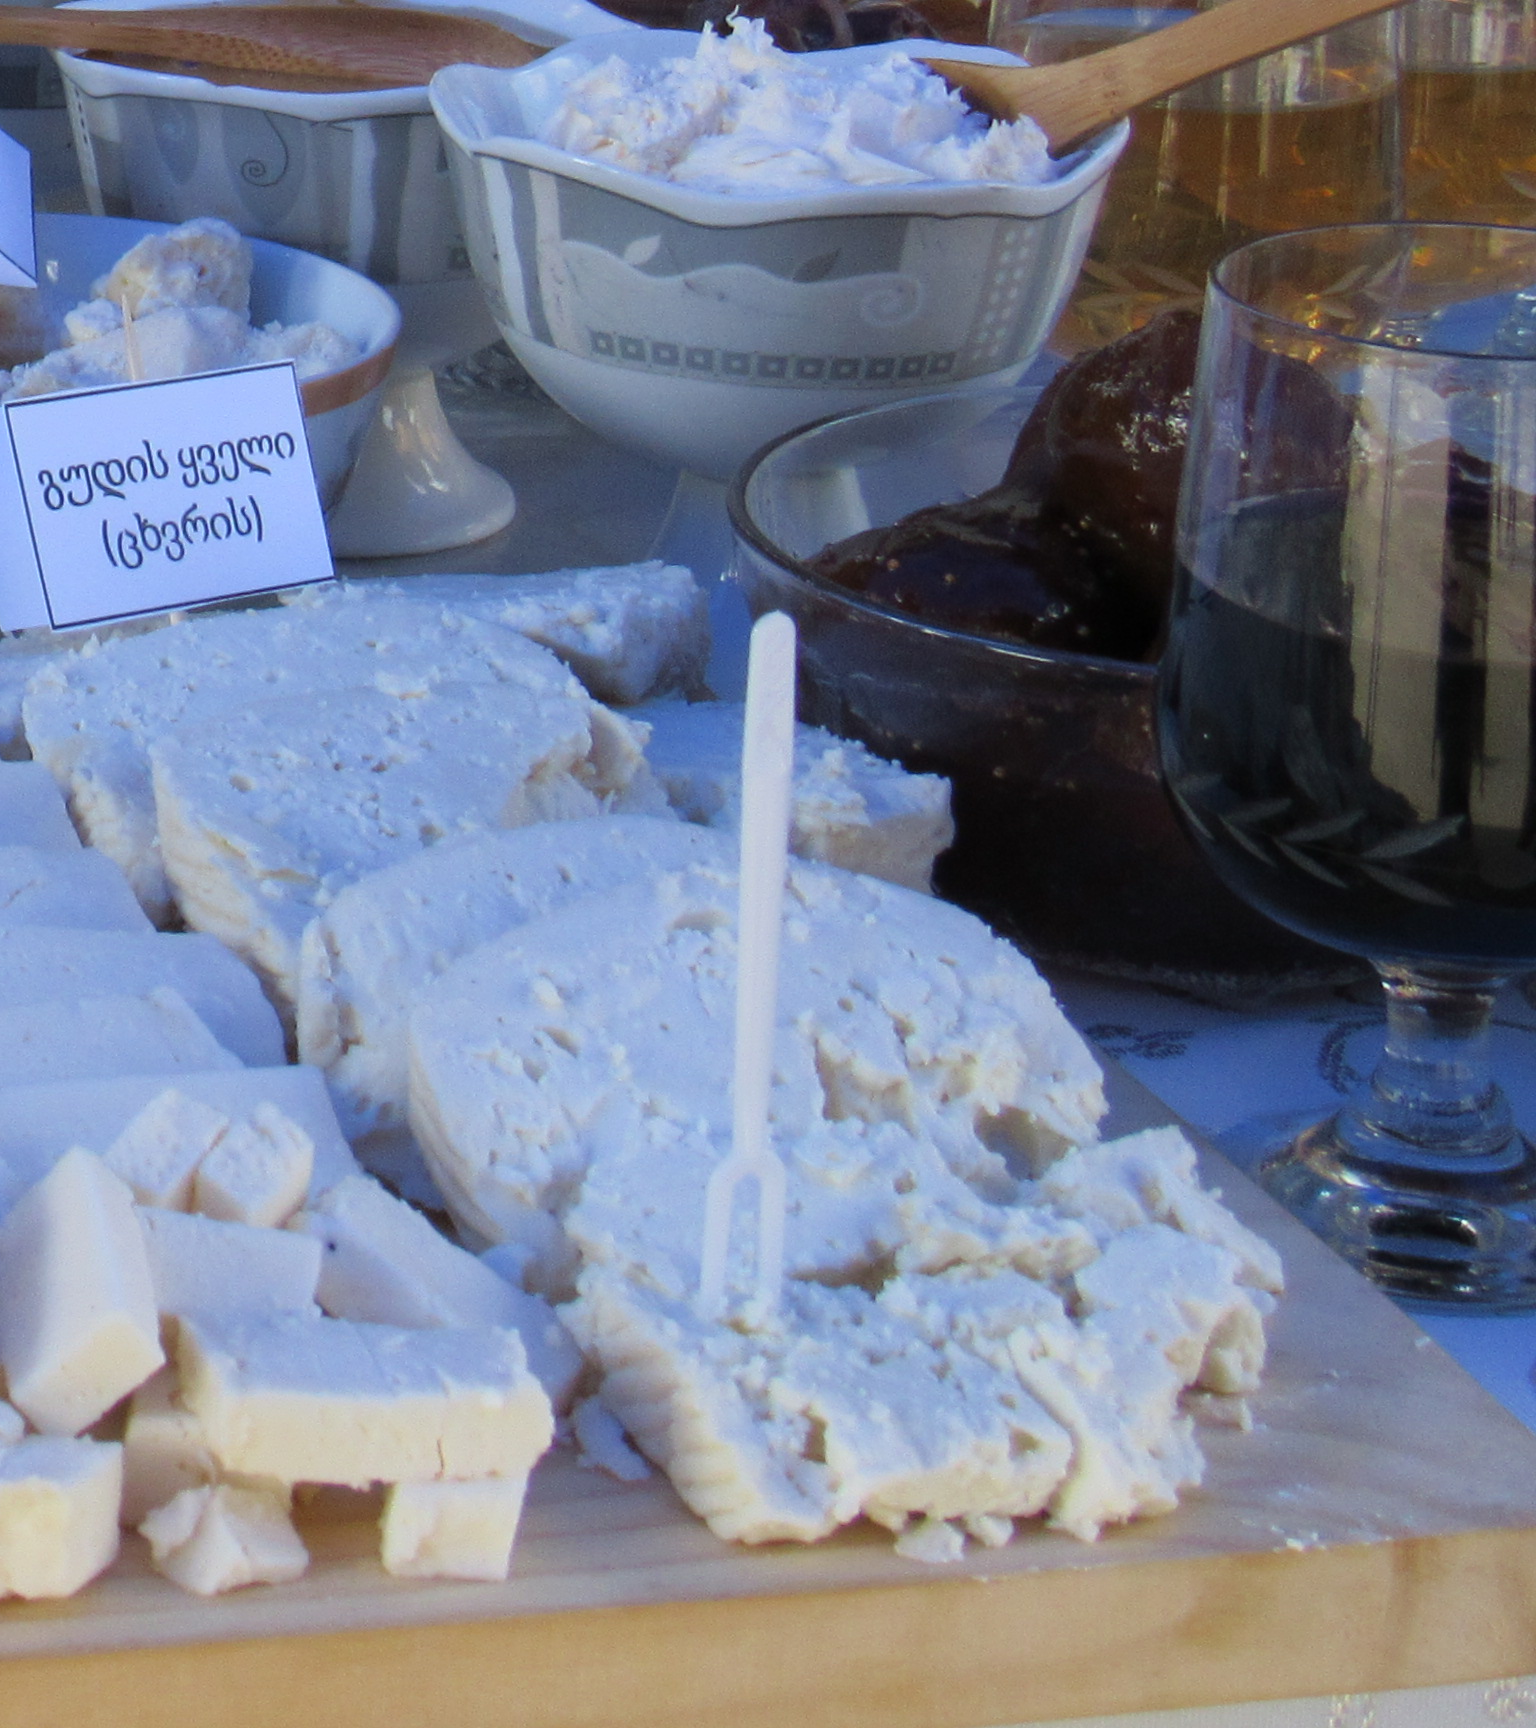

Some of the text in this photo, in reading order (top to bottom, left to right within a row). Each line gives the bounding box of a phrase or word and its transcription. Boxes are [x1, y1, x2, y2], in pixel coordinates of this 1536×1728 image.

[36, 430, 296, 511] გუდის ყველი
[101, 494, 264, 570] (ცხვრის)
